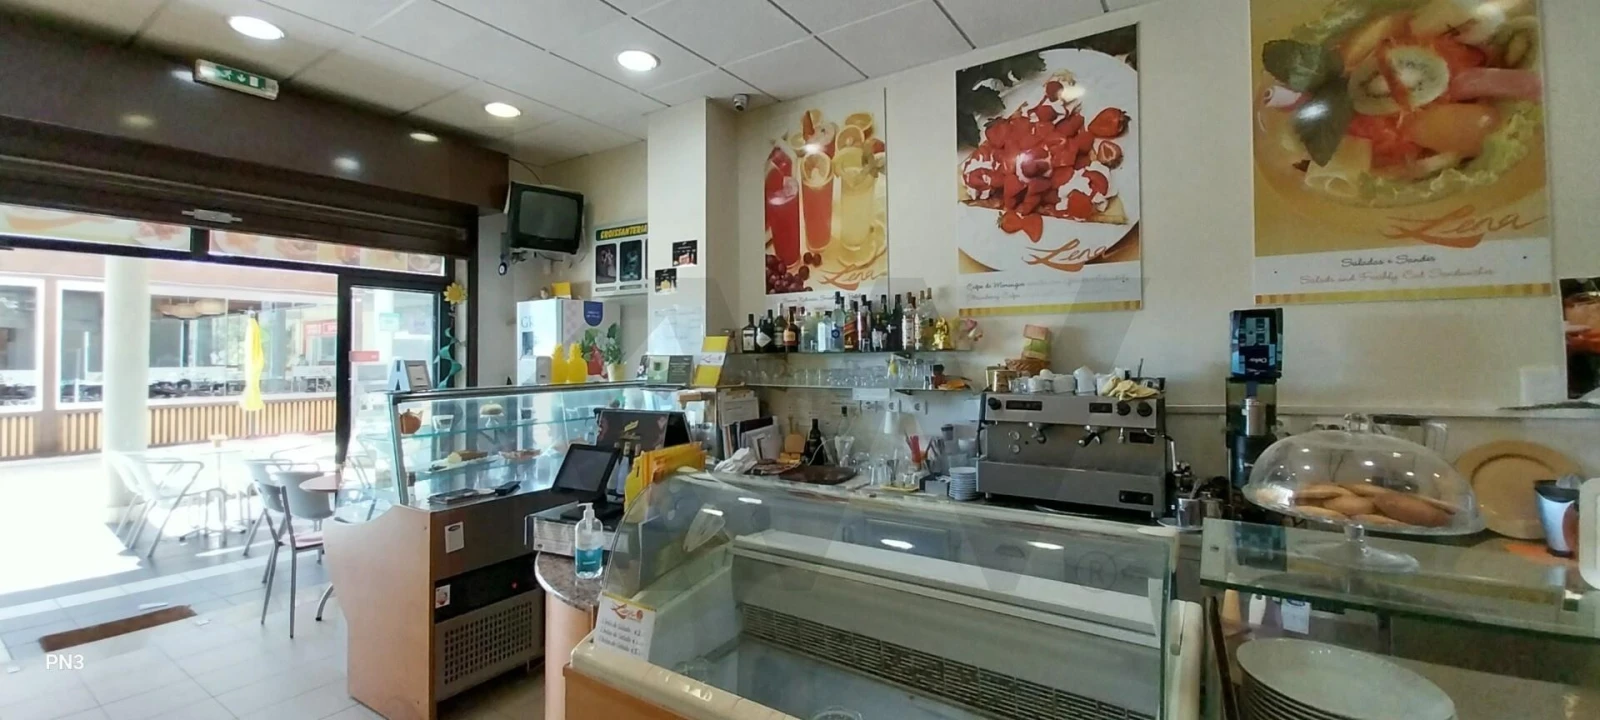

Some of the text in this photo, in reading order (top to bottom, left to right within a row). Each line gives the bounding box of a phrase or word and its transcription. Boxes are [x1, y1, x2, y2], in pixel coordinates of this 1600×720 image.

[1380, 204, 1547, 248] Lena
[1021, 238, 1117, 272] Lena
[818, 263, 888, 291] Lena
